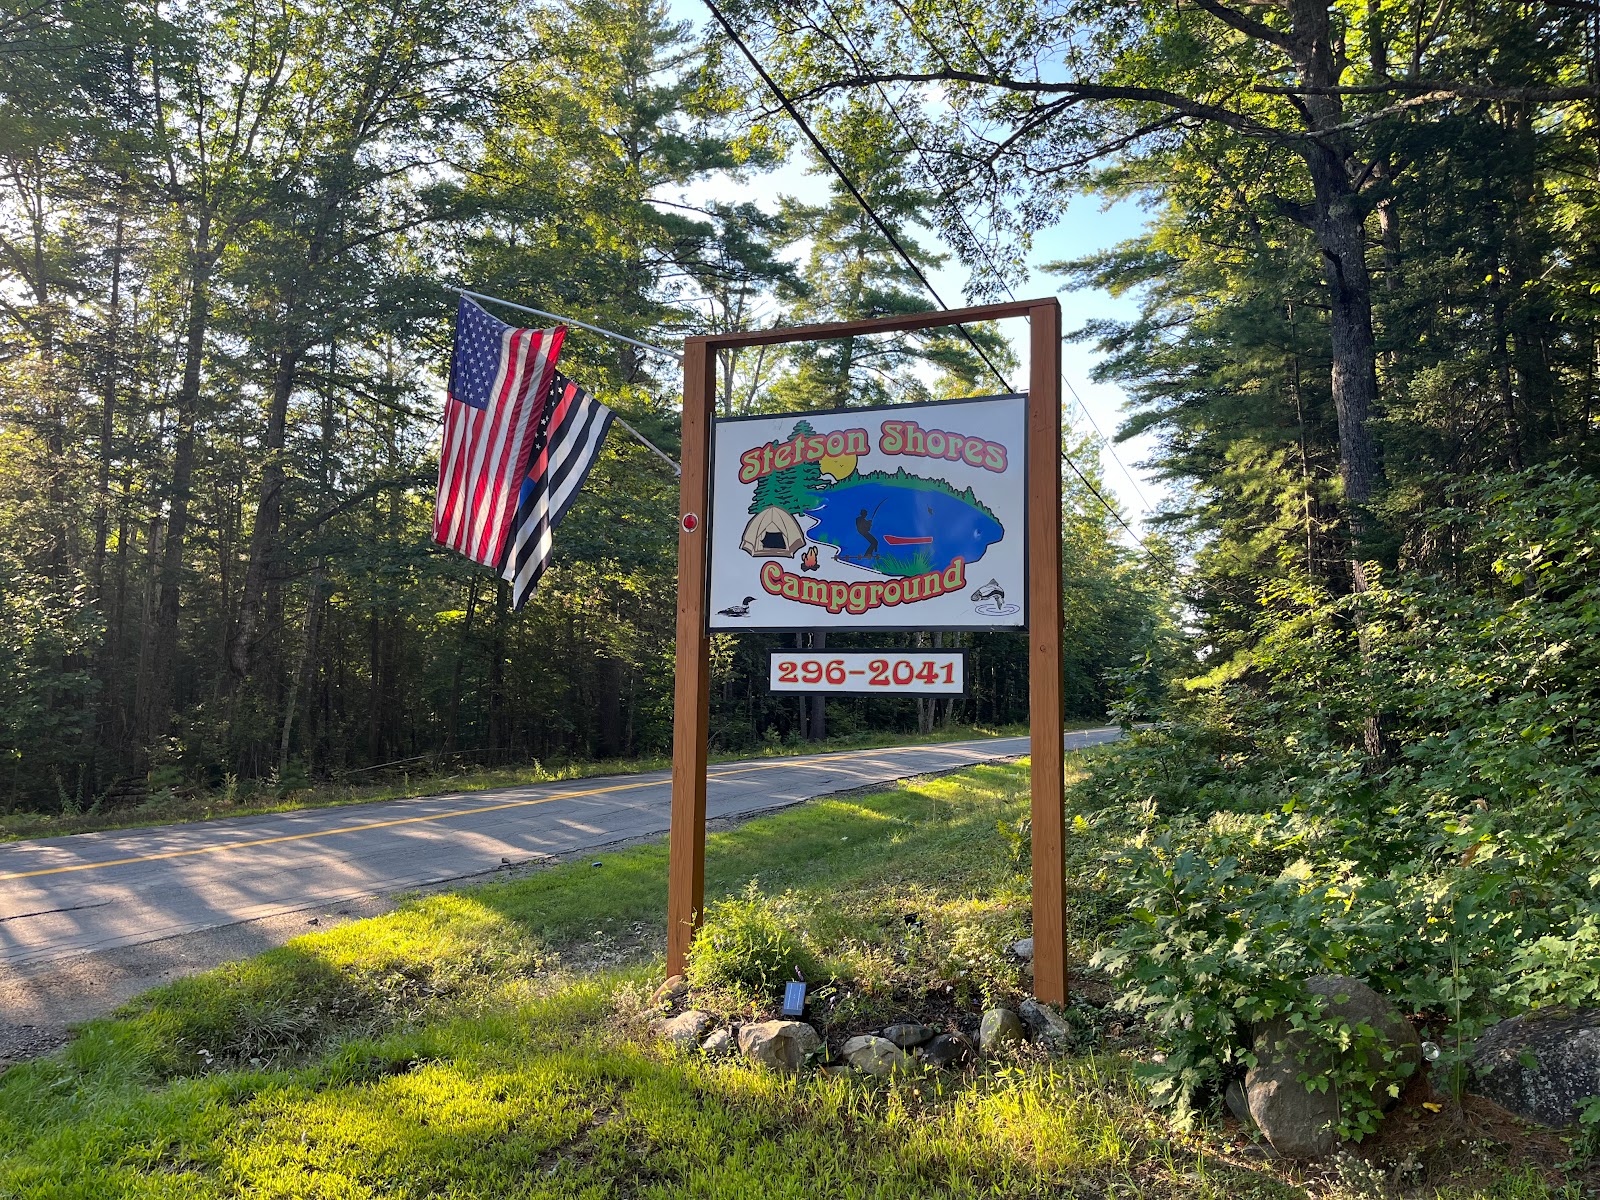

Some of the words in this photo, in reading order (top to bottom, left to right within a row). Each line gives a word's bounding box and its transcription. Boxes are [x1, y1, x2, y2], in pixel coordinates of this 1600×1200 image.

[740, 429, 870, 483] Stetson
[881, 421, 1007, 472] Shores
[761, 557, 966, 614] Campground
[777, 659, 955, 686] 296-2041
